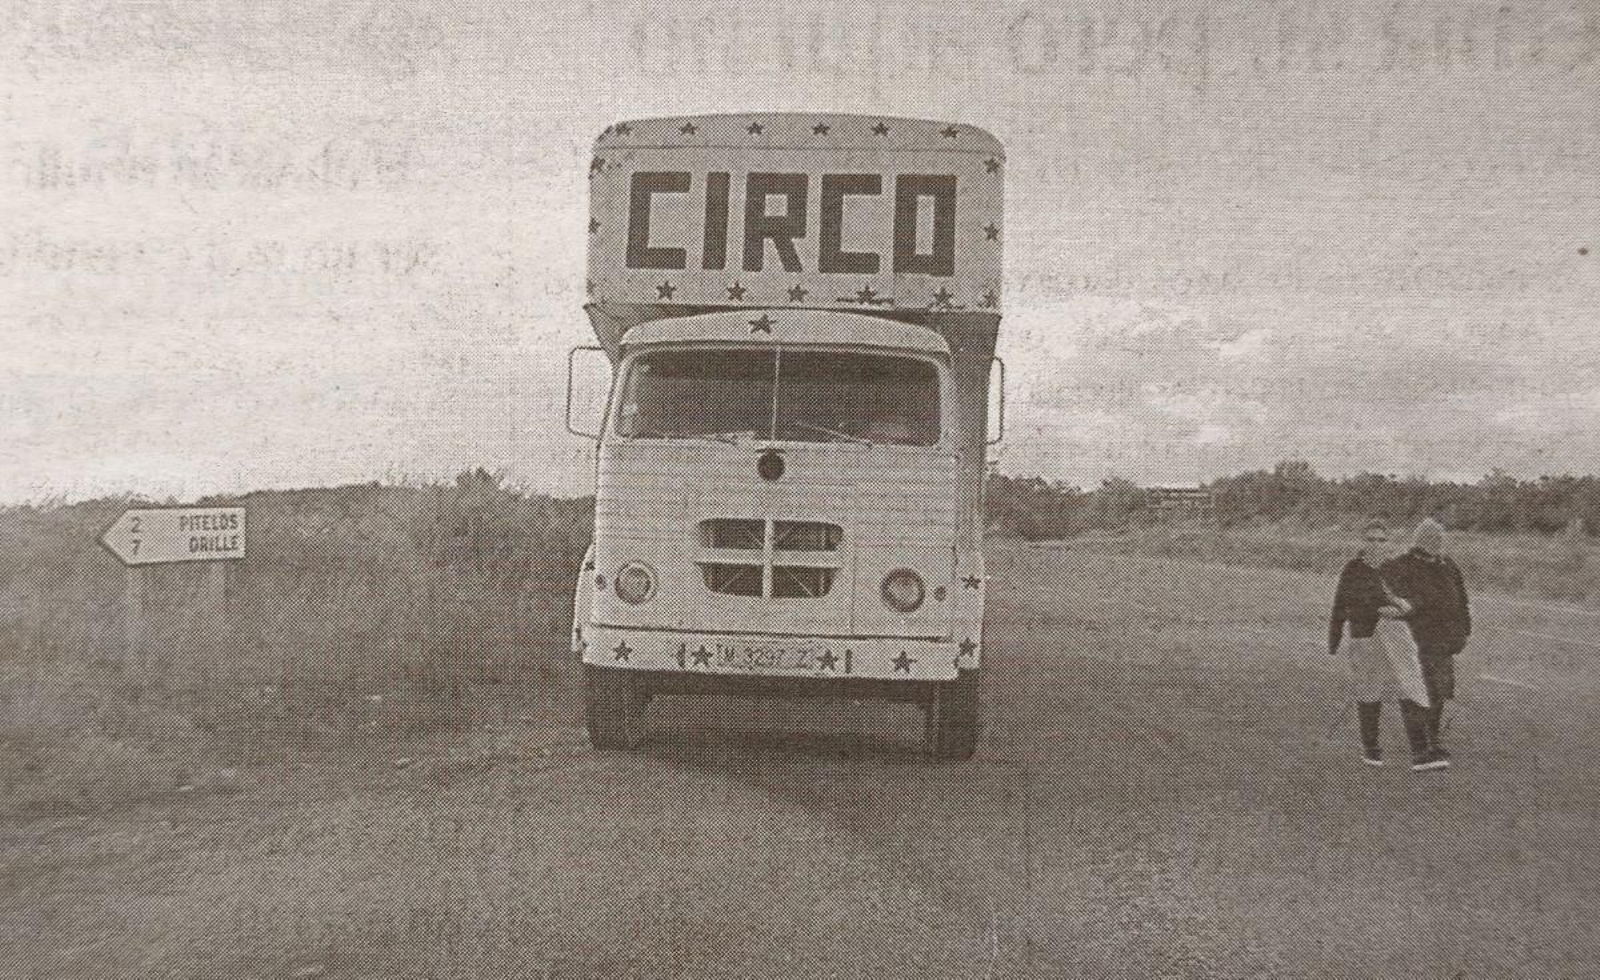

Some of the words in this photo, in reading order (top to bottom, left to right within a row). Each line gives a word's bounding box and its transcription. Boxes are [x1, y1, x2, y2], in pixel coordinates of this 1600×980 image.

[625, 171, 957, 277] CIRCO
[131, 516, 141, 533] 2
[131, 538, 142, 556] 7
